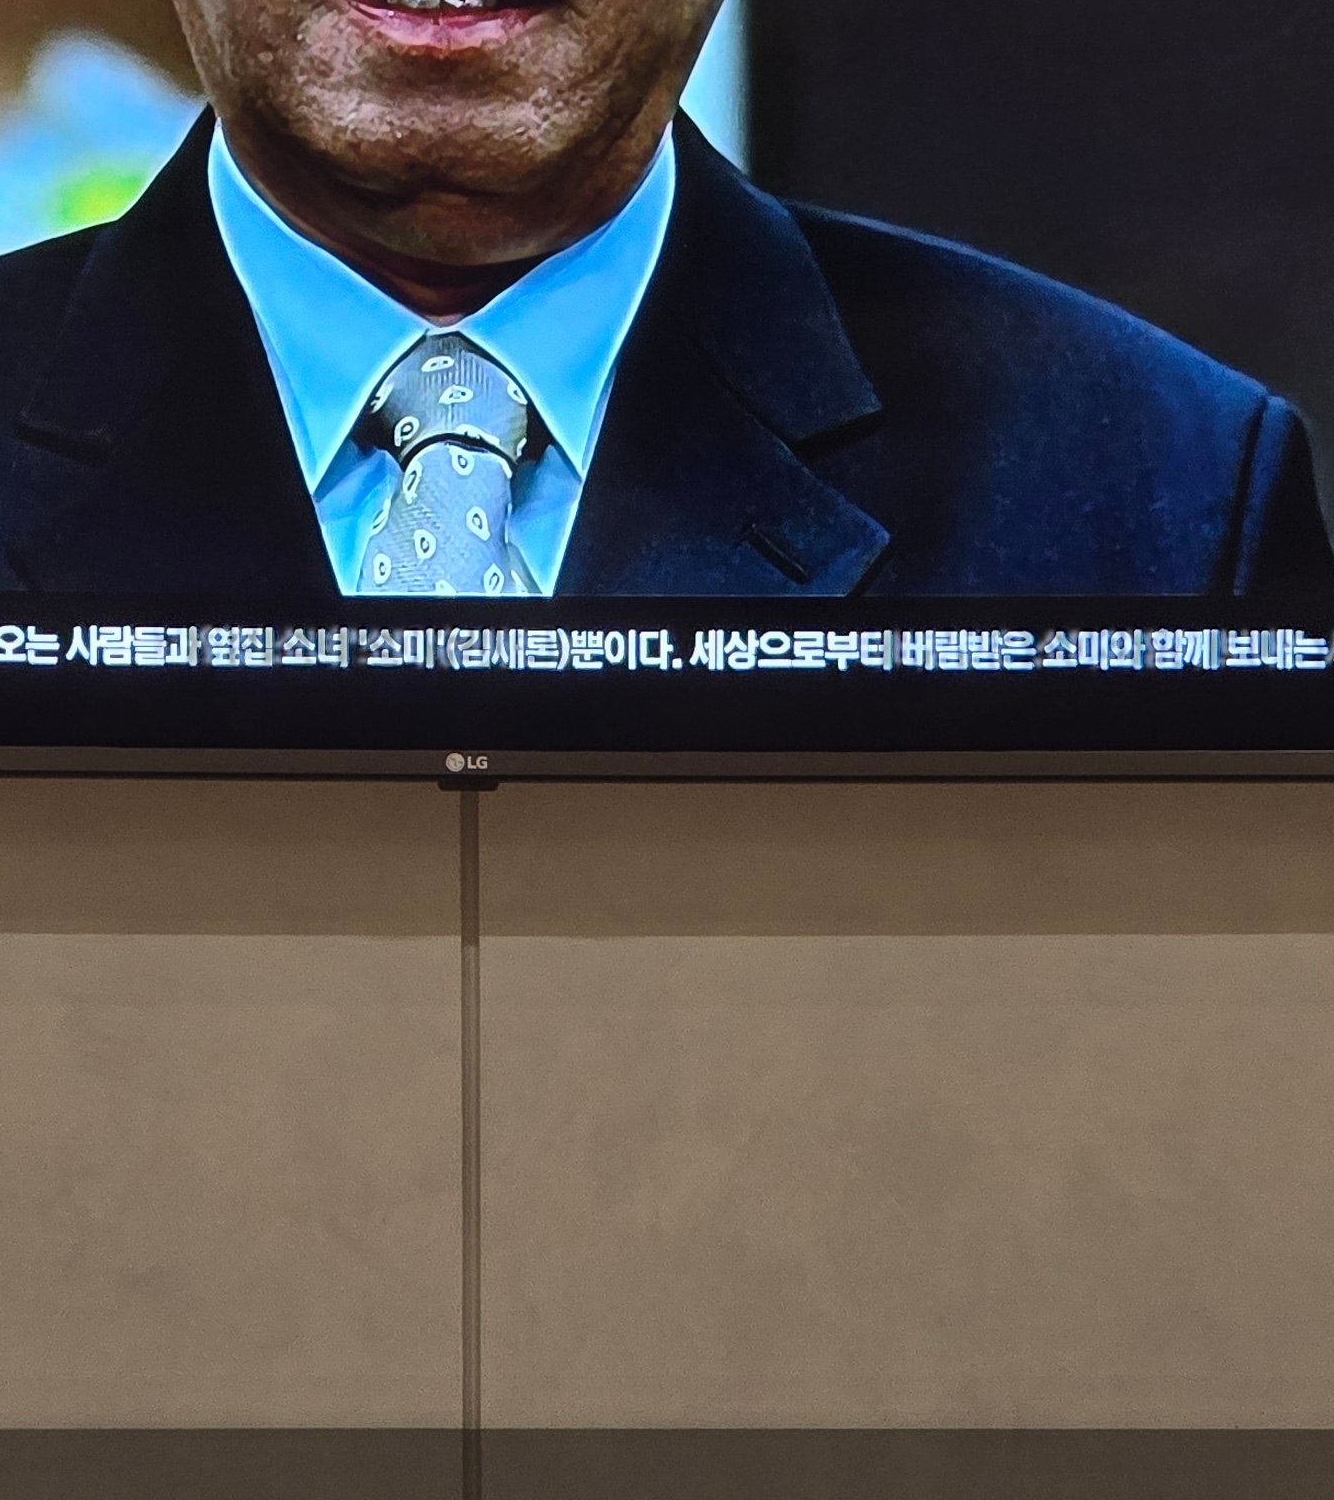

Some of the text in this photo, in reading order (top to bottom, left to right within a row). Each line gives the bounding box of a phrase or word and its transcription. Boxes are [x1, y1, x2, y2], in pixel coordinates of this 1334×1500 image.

[66, 625, 201, 666] 사람들과
[208, 626, 273, 668] 옆집
[282, 626, 349, 668] 소녀
[689, 629, 891, 670] 세상으로부터
[902, 630, 1037, 670] 버림받은
[1043, 630, 1144, 670] 소미와
[1152, 630, 1220, 670] 함께
[1228, 630, 1329, 670] 보내는
[467, 756, 488, 769] LG
